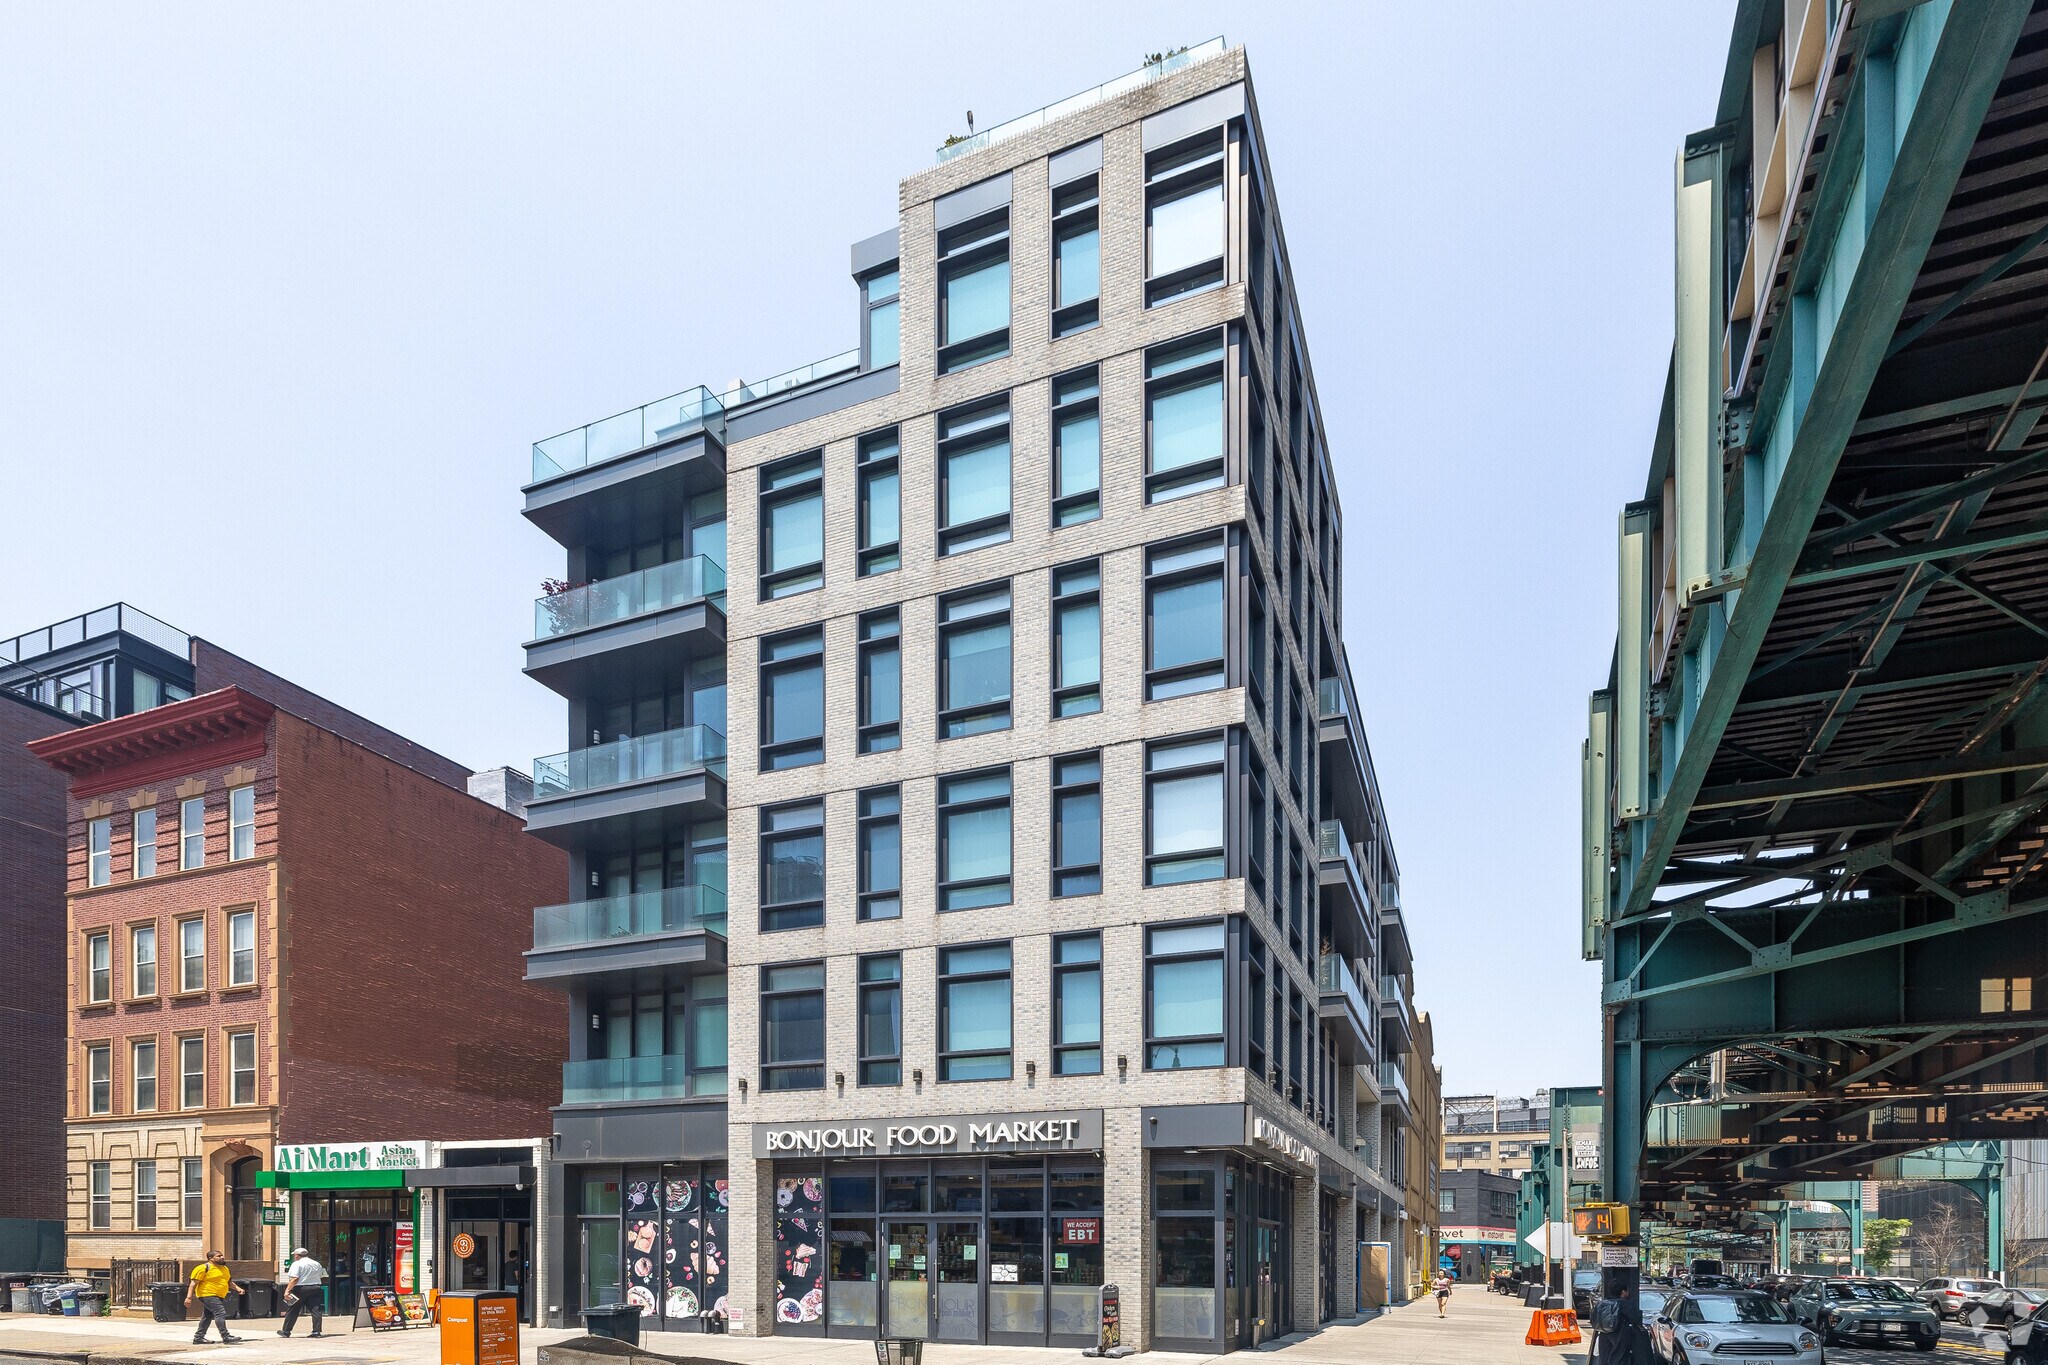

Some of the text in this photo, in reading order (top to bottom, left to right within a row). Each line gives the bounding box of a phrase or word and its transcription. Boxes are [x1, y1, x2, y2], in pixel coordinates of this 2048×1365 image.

[766, 1119, 1080, 1152] BONJOUR FOOD MARKET
[381, 1144, 413, 1155] Asian
[277, 1146, 368, 1170] Ai Mart
[376, 1156, 417, 1167] Market
[1597, 1214, 1609, 1230] 14
[1068, 1229, 1095, 1240] EBT
